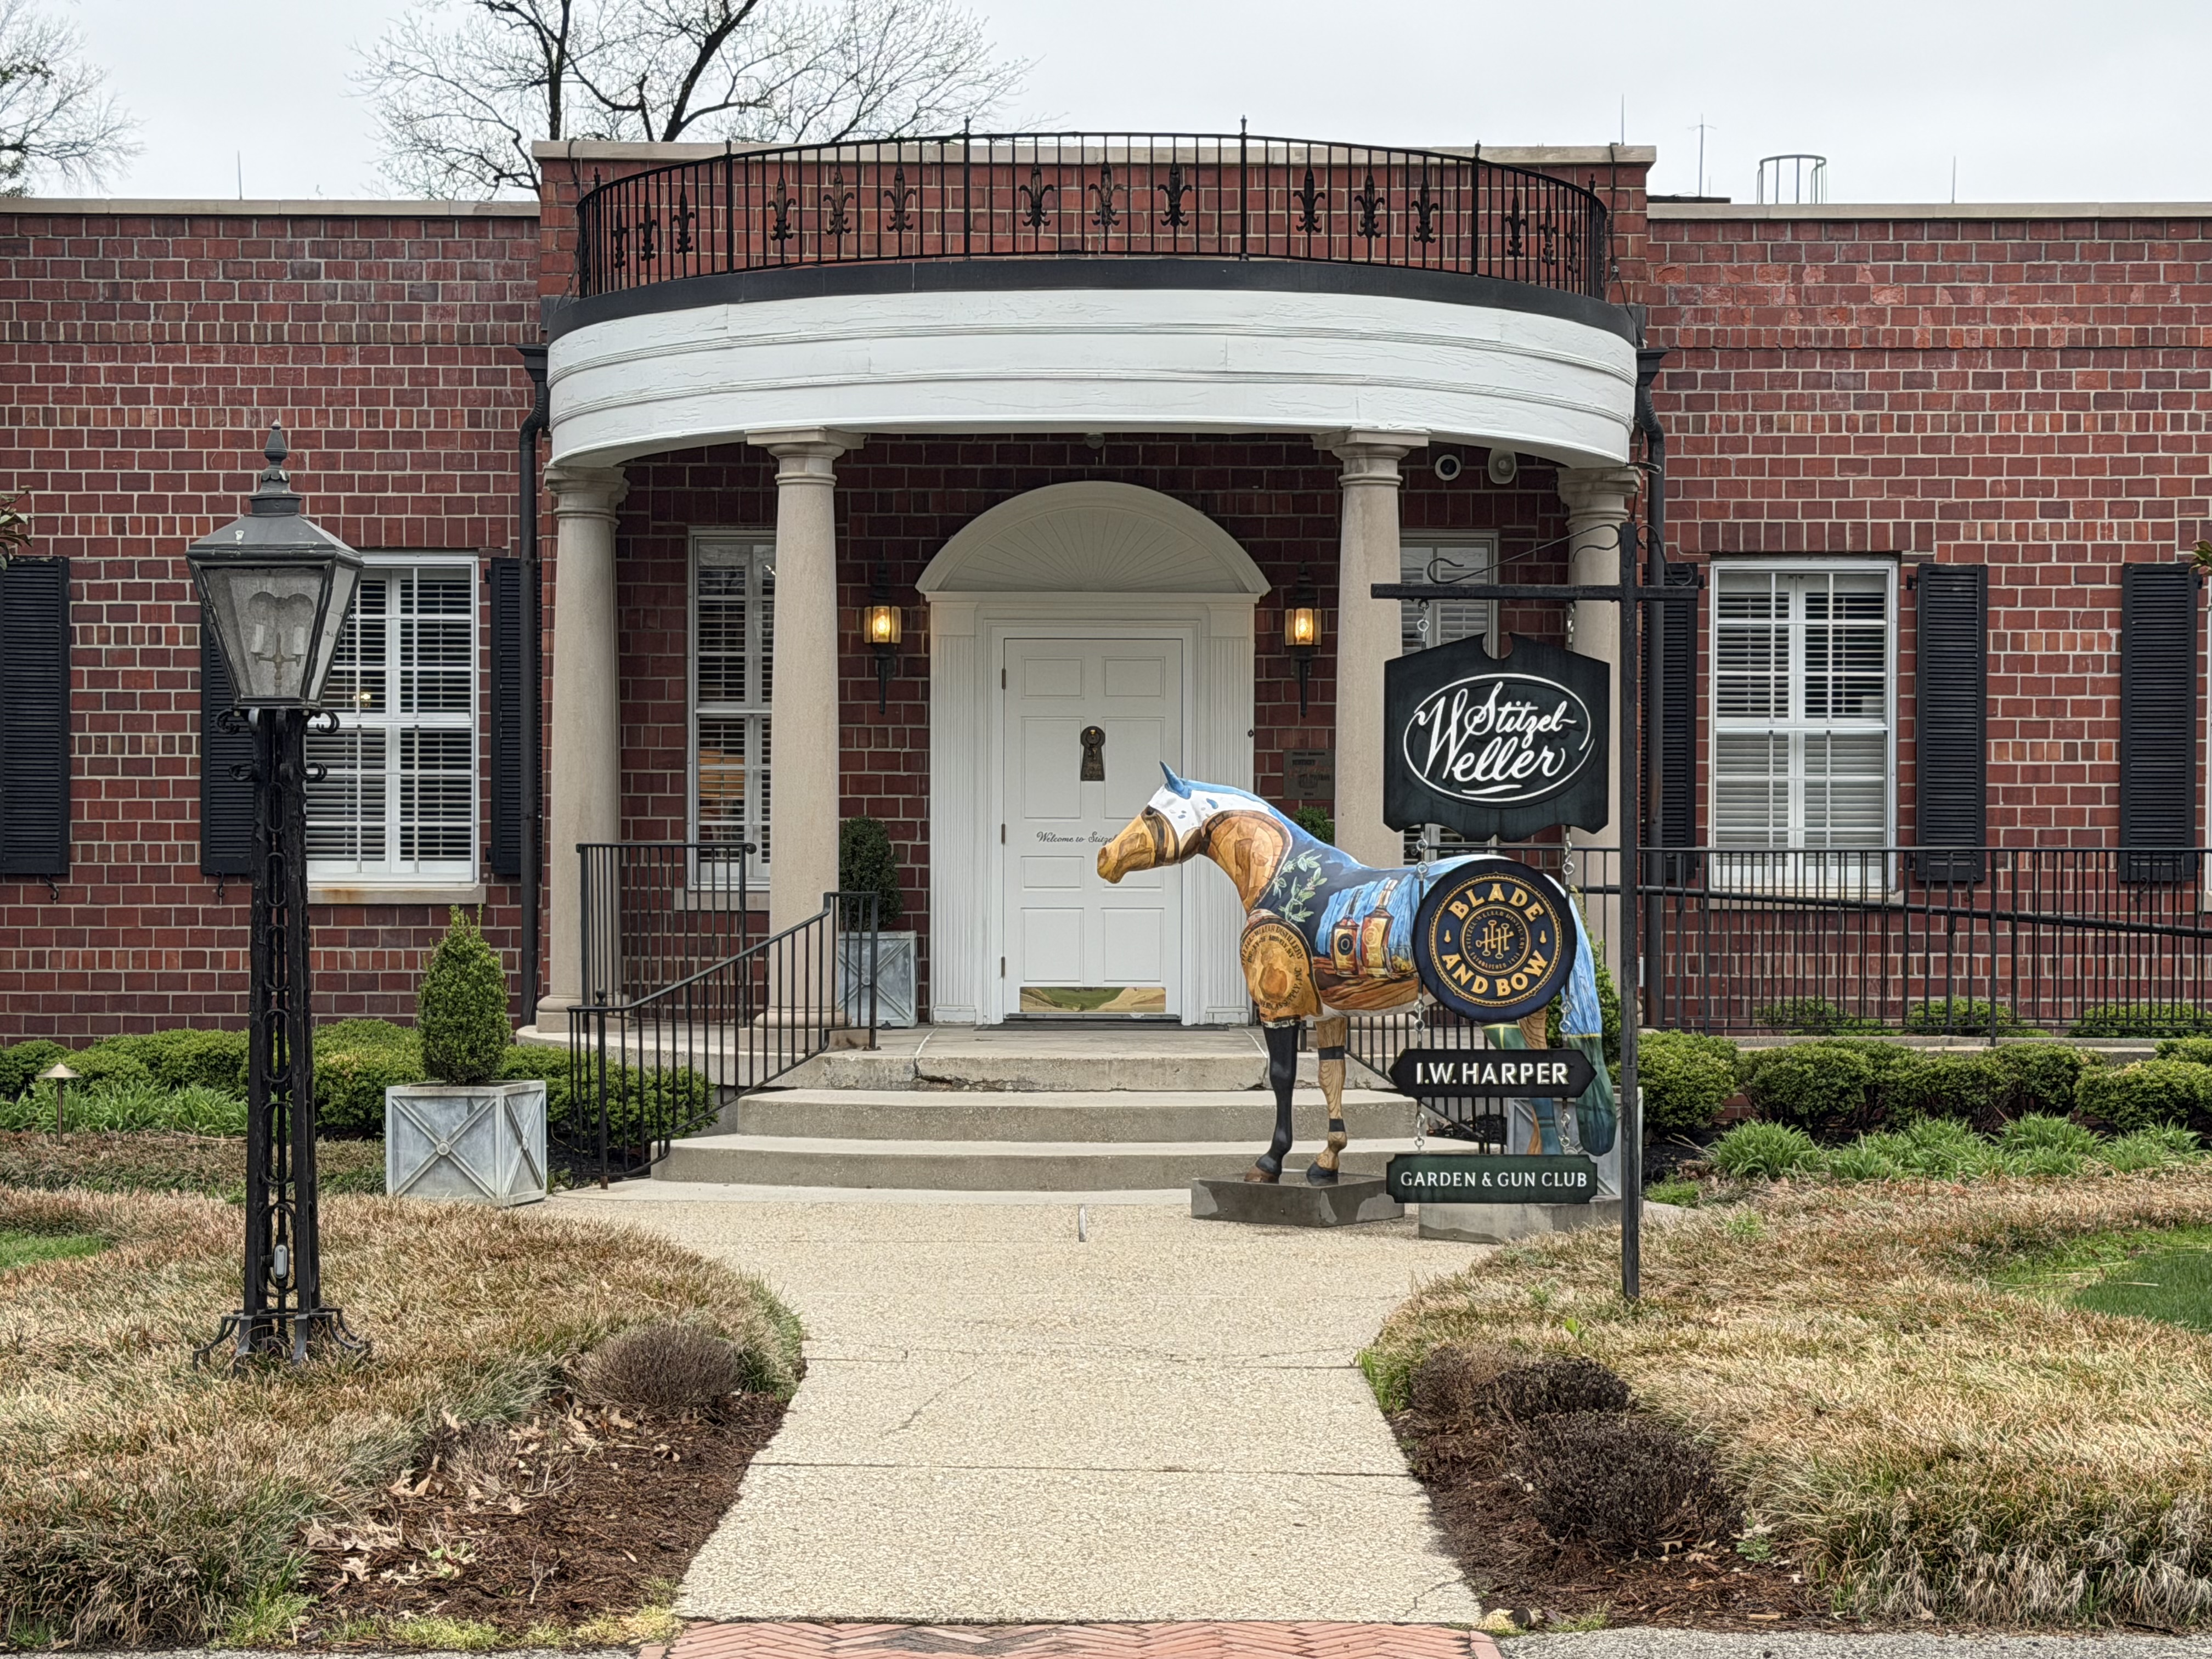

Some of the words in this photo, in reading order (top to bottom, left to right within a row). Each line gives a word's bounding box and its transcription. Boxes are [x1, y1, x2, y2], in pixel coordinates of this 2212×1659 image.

[1464, 681, 1577, 748] Stitzel-
[1418, 688, 1566, 782] Weller
[1036, 831, 1074, 843] Welcome
[1448, 883, 1544, 922] BLADE
[1441, 953, 1488, 994] AND
[1494, 950, 1548, 997] BOW
[1416, 1062, 1457, 1085] I.W.
[1462, 1062, 1569, 1085] HARPER
[1400, 1171, 1476, 1187] GARDEN
[1481, 1172, 1493, 1187] &
[1497, 1172, 1536, 1187] GUN
[1541, 1172, 1587, 1187] CLUB
